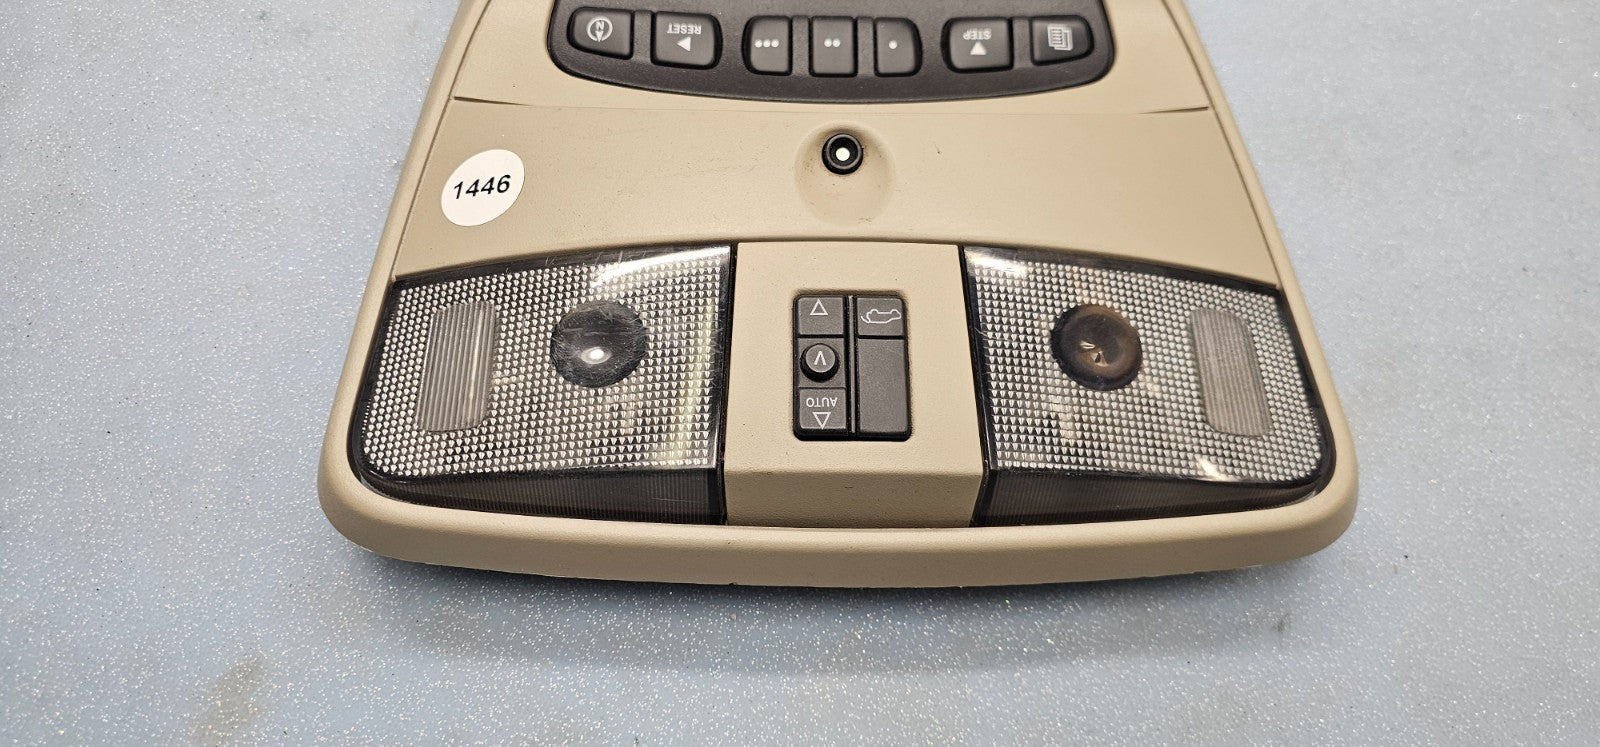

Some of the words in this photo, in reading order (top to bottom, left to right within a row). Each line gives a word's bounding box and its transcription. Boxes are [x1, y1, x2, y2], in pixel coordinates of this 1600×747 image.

[666, 22, 702, 35] RESET
[962, 28, 992, 40] STEP
[453, 174, 511, 199] 1446
[806, 397, 838, 408] AUTO
